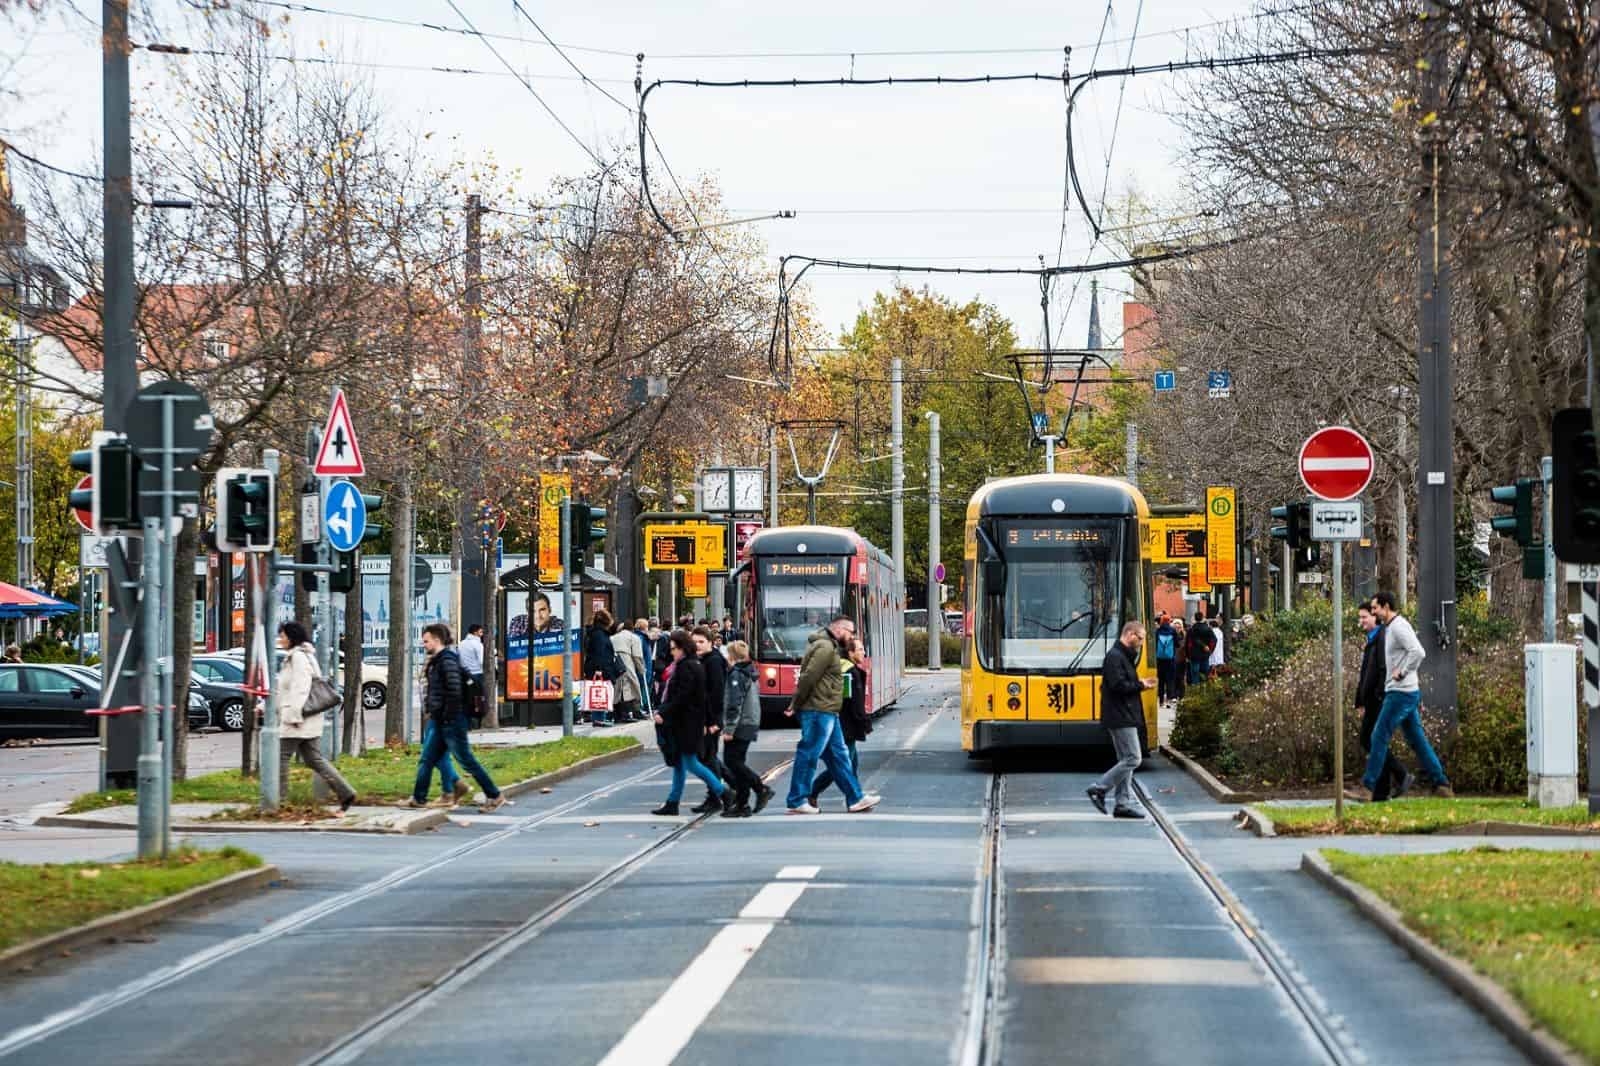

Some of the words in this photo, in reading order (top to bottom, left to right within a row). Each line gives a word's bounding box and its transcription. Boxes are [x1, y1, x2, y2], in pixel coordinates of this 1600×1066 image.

[772, 564, 778, 576] 7
[782, 564, 835, 575] Pennrich
[535, 669, 561, 690] ils
